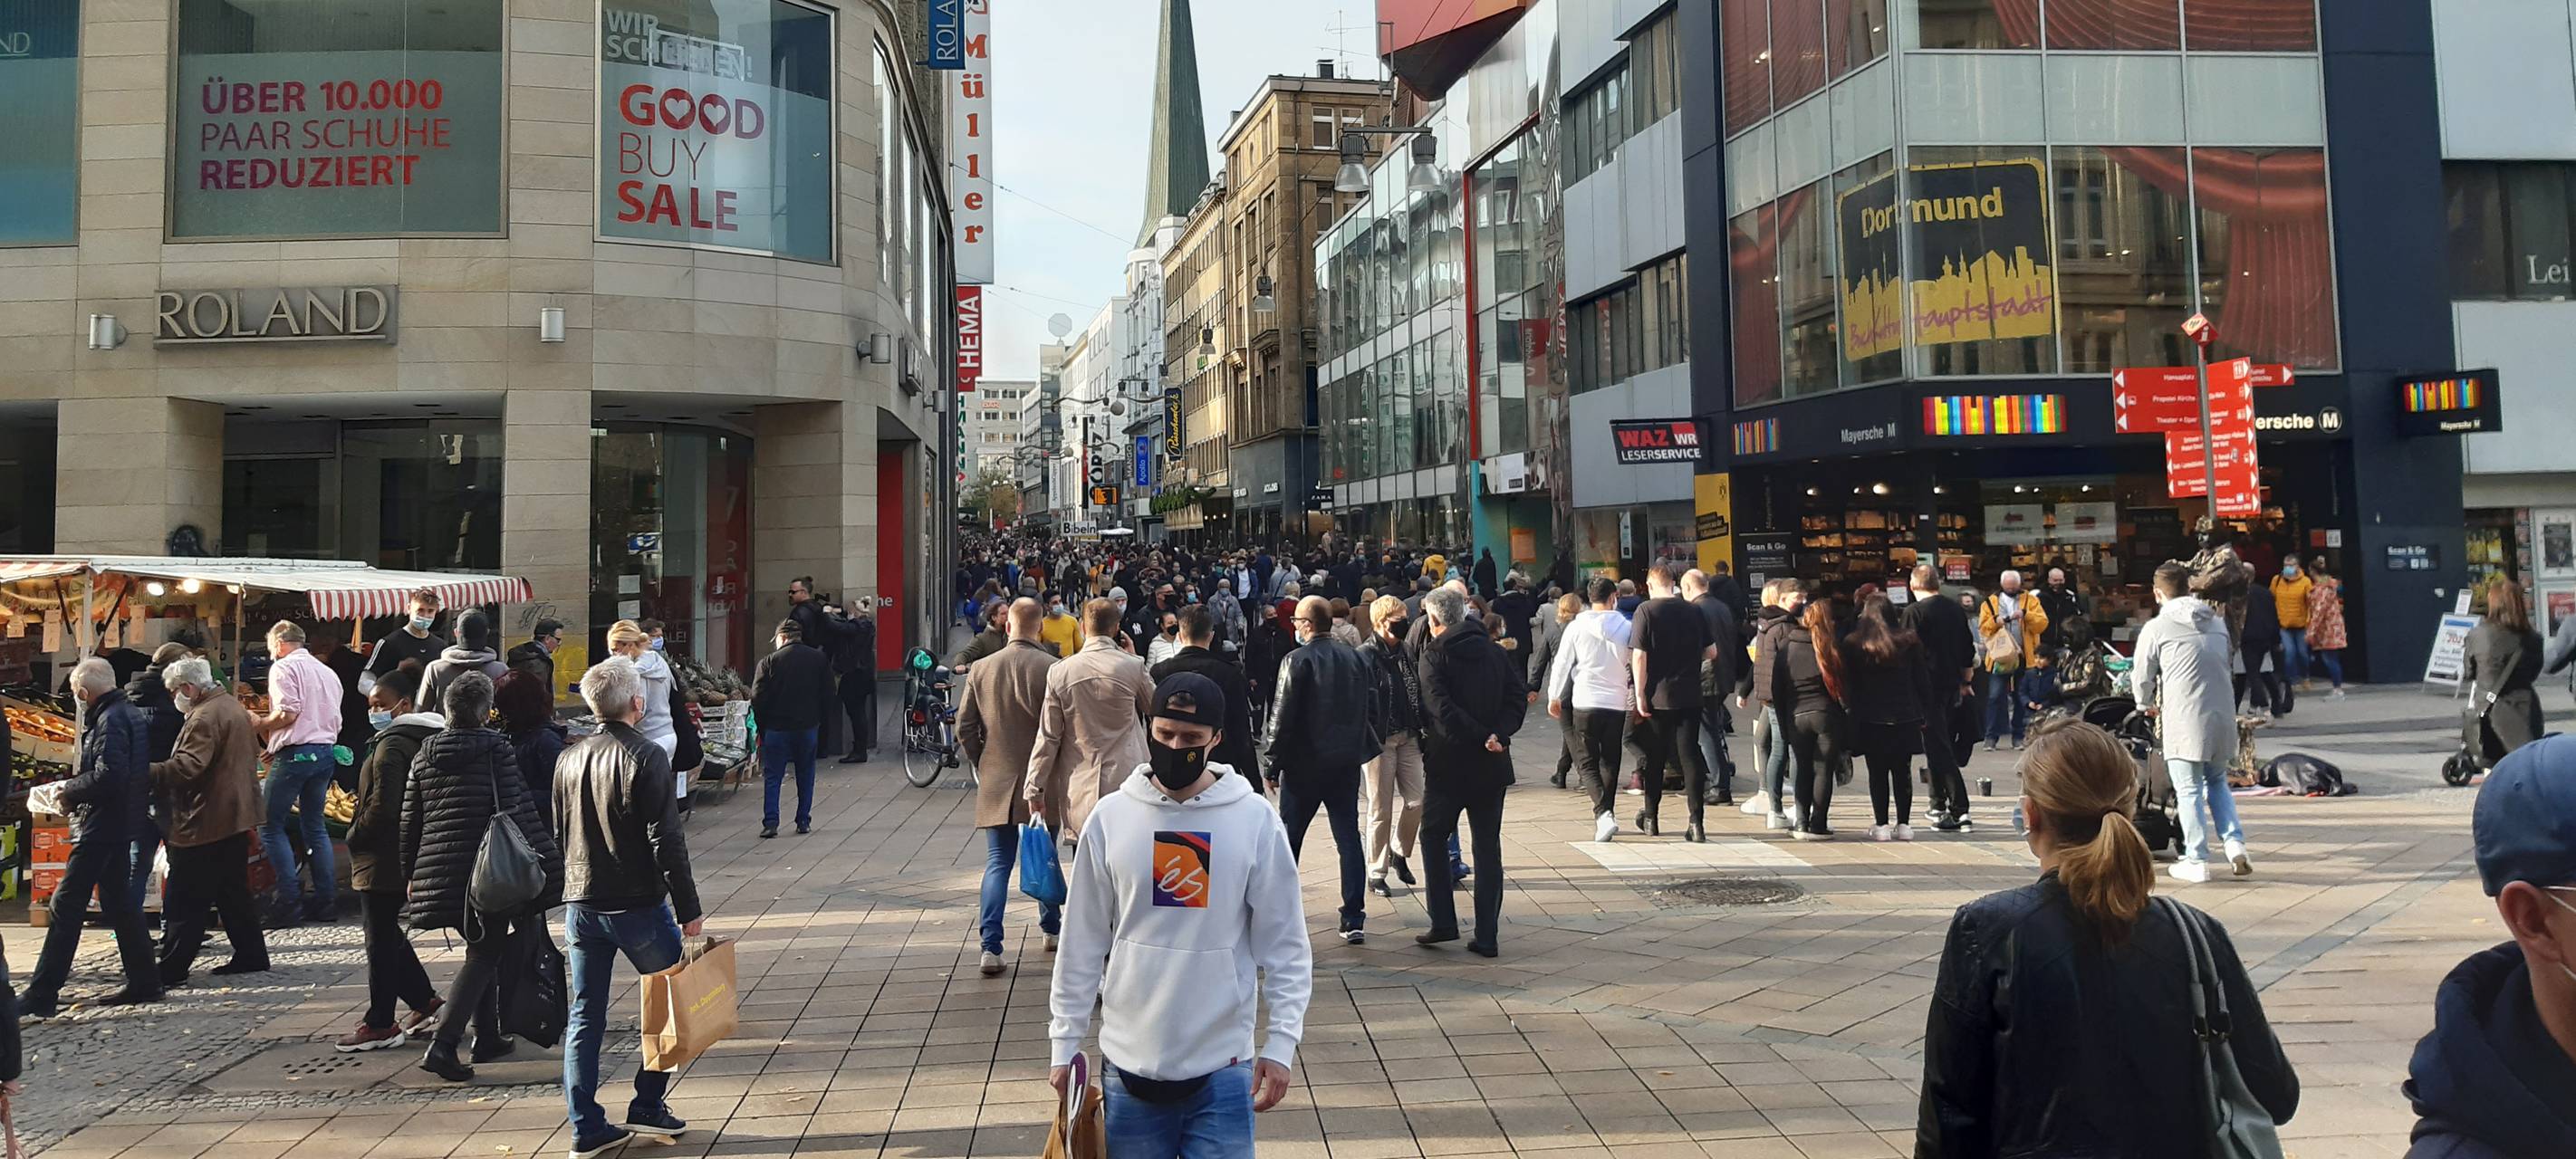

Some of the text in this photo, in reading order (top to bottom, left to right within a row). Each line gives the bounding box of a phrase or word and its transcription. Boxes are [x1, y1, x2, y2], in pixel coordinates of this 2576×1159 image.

[607, 8, 659, 36] WIR
[0, 32, 30, 53] ND
[202, 76, 443, 114] ÜBER 10.000
[620, 84, 764, 139] GOOD
[200, 118, 451, 152] PAAR SCHUHE
[960, 34, 988, 244] Müller
[198, 154, 420, 190] REDUZIERT
[620, 132, 706, 180] BUY
[617, 180, 739, 231] SALE
[1861, 187, 2004, 238] Dortmund
[2526, 254, 2570, 284] Lei
[156, 288, 387, 338] ROLAND
[958, 295, 979, 368] HEMA
[1618, 429, 1698, 448] WAZ WR
[1841, 423, 1896, 444] Mayersche M
[1138, 459, 1146, 483] Apollo
[1621, 447, 1702, 461] LESERSERVICE
[1063, 522, 1096, 534] Bibeln
[2388, 546, 2407, 555] Scan
[2415, 546, 2427, 555] Go
